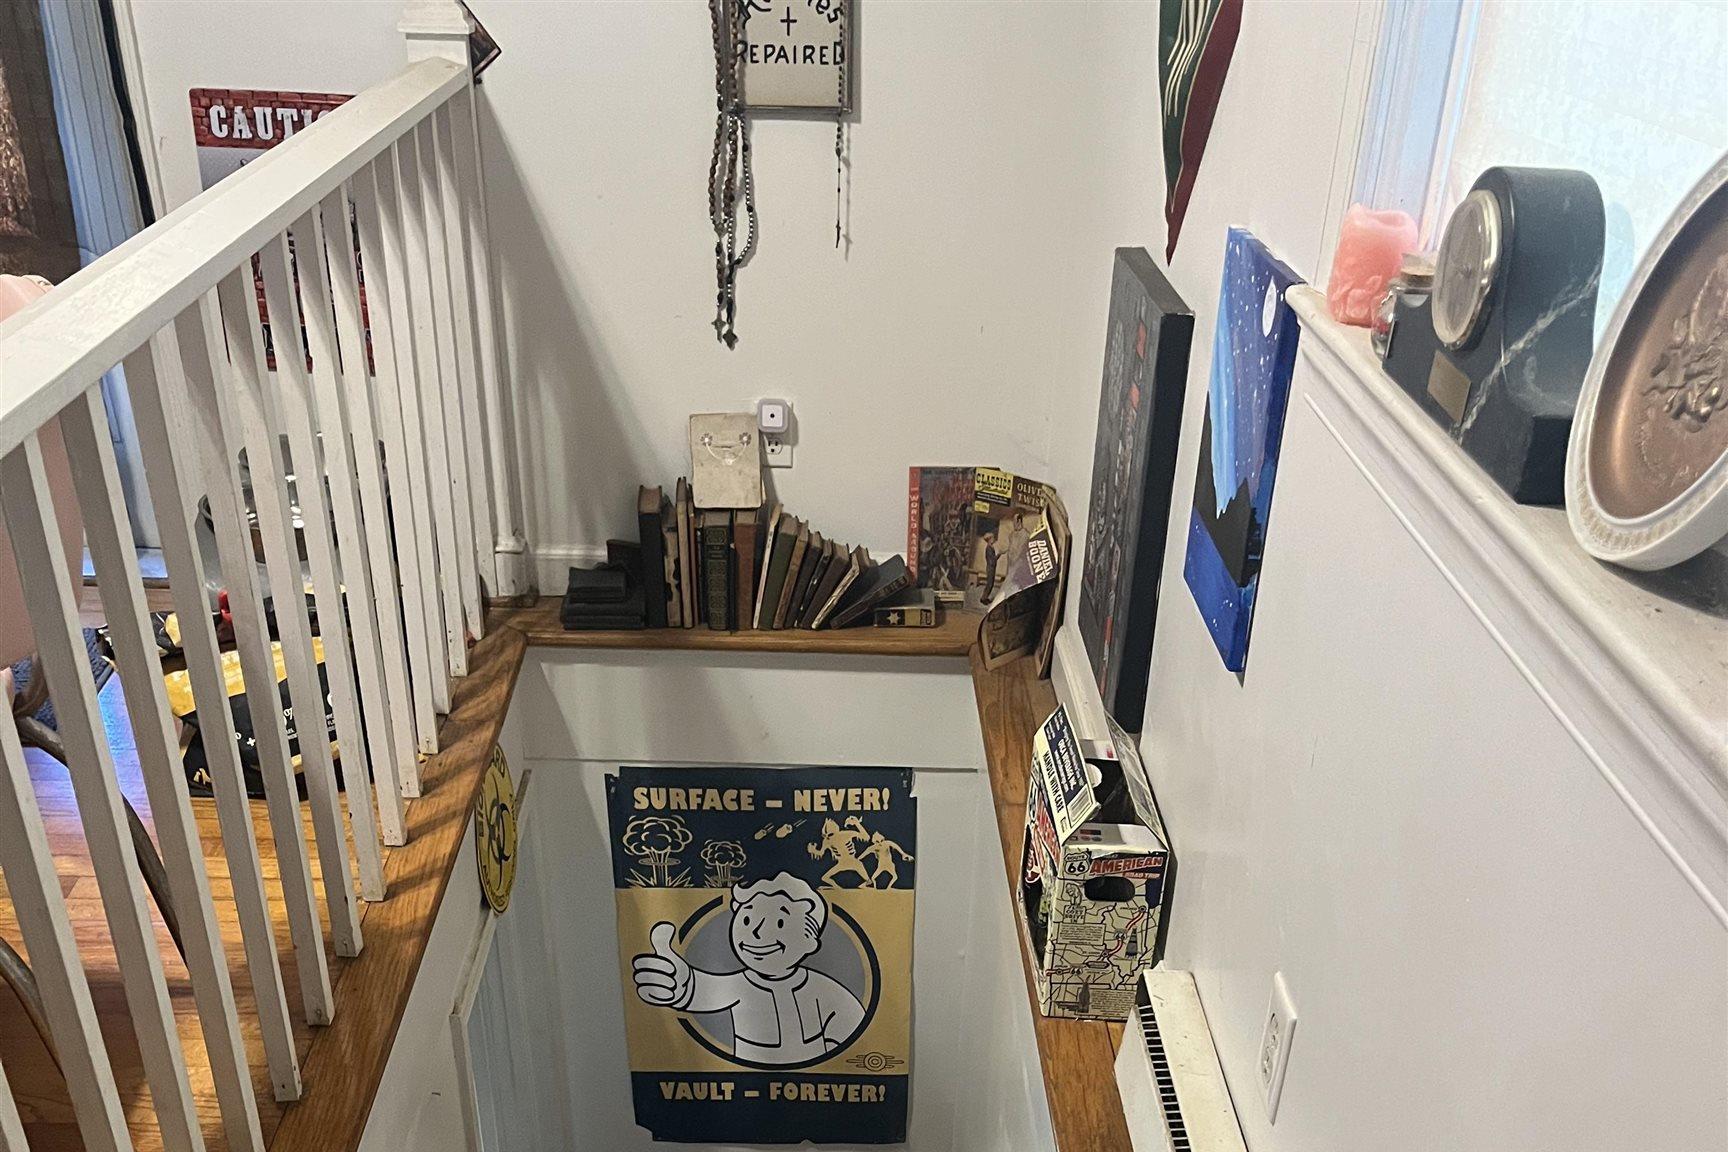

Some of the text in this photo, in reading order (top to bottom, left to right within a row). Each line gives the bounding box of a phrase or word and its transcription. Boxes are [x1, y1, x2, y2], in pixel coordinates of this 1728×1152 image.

[737, 40, 845, 65] REPAIRED
[209, 104, 332, 141] CAUTI
[976, 473, 1012, 491] CLASSICS
[1017, 483, 1043, 496] OLIVE
[1029, 540, 1047, 584] BOONE
[1043, 750, 1055, 779] HANDLE
[1050, 776, 1060, 797] WITH
[633, 787, 755, 811] SURFACE
[794, 788, 890, 812] NEVER!
[1054, 793, 1065, 813] CARE
[1067, 862, 1086, 873] 66
[1089, 857, 1164, 876] AMERICAN
[659, 1081, 736, 1101] VAULT
[769, 1081, 886, 1103] FOREVER!
